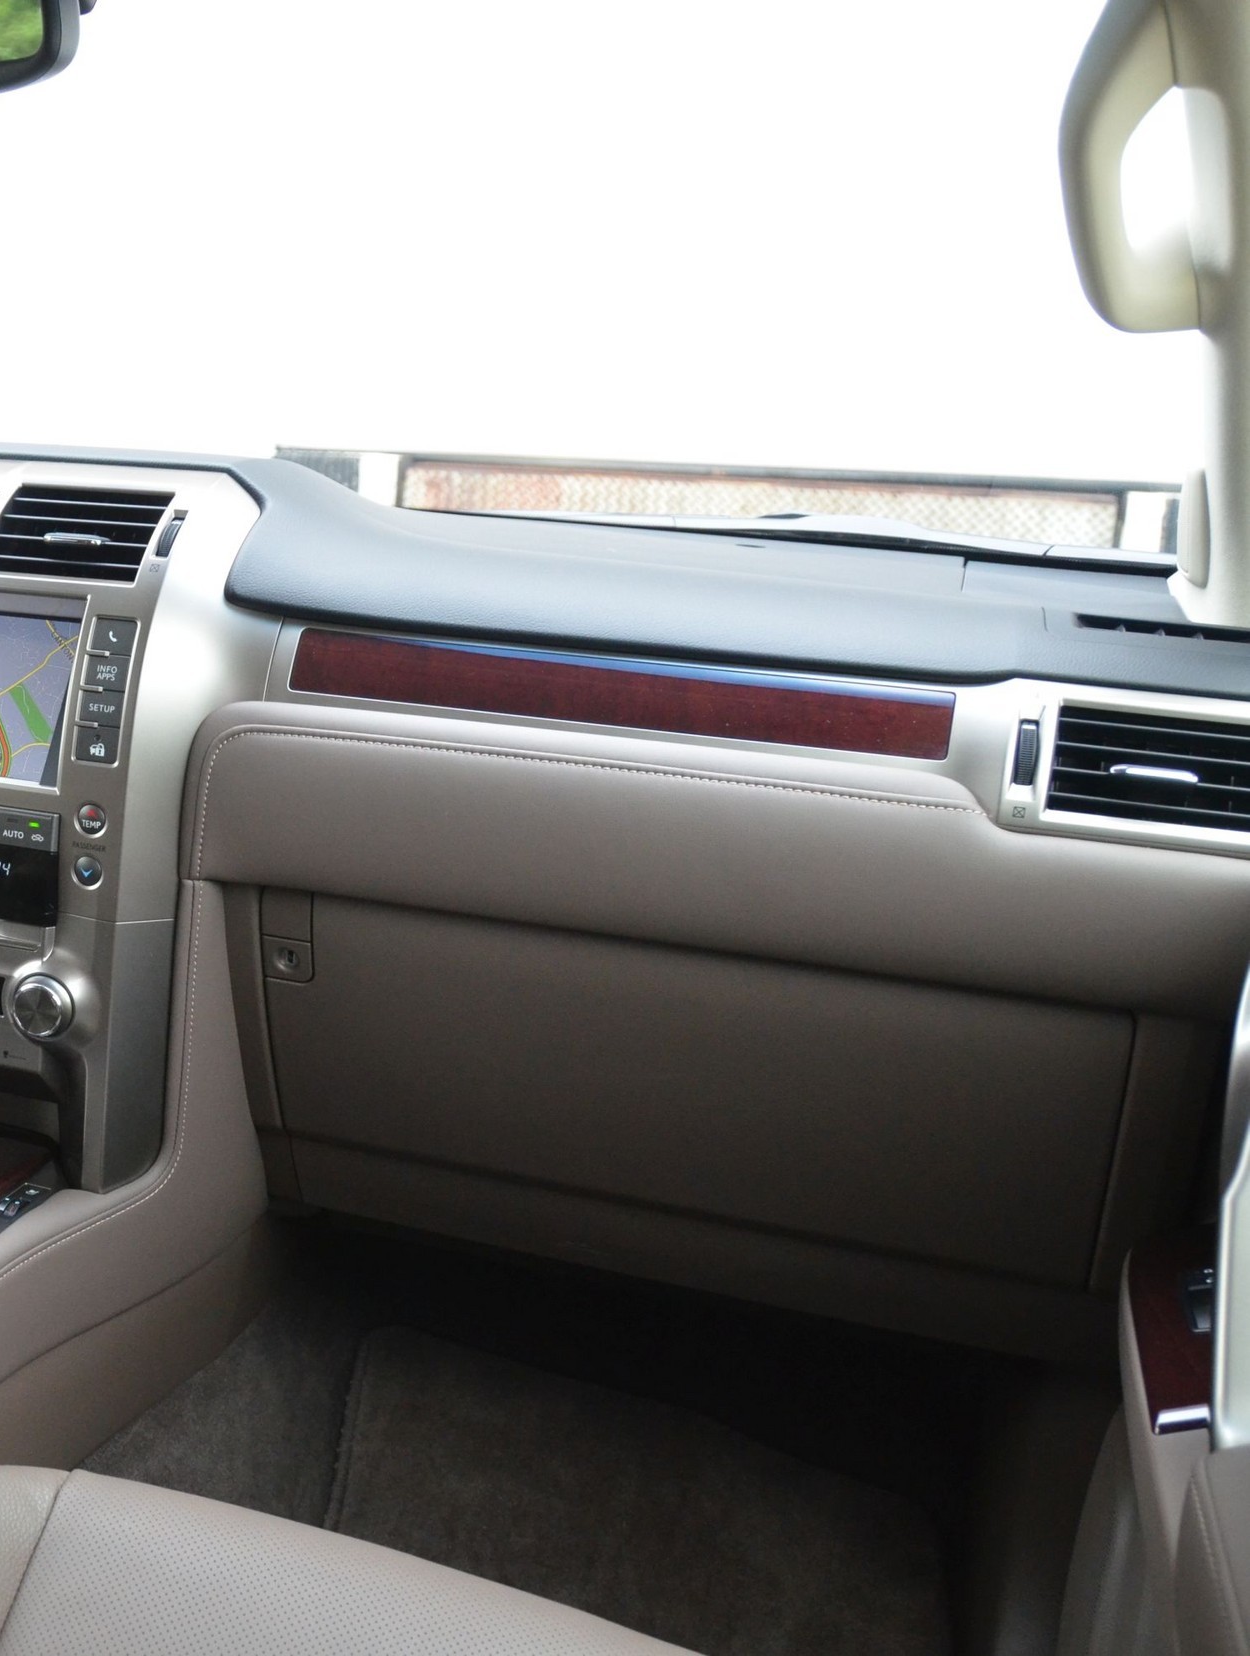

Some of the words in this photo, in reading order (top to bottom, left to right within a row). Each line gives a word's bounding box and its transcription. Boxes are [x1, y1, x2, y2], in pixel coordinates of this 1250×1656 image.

[96, 664, 118, 674] INFO
[96, 672, 116, 681] APPS
[88, 703, 116, 713] SETUP
[82, 819, 102, 829] TEMP
[2, 829, 24, 839] AUTO
